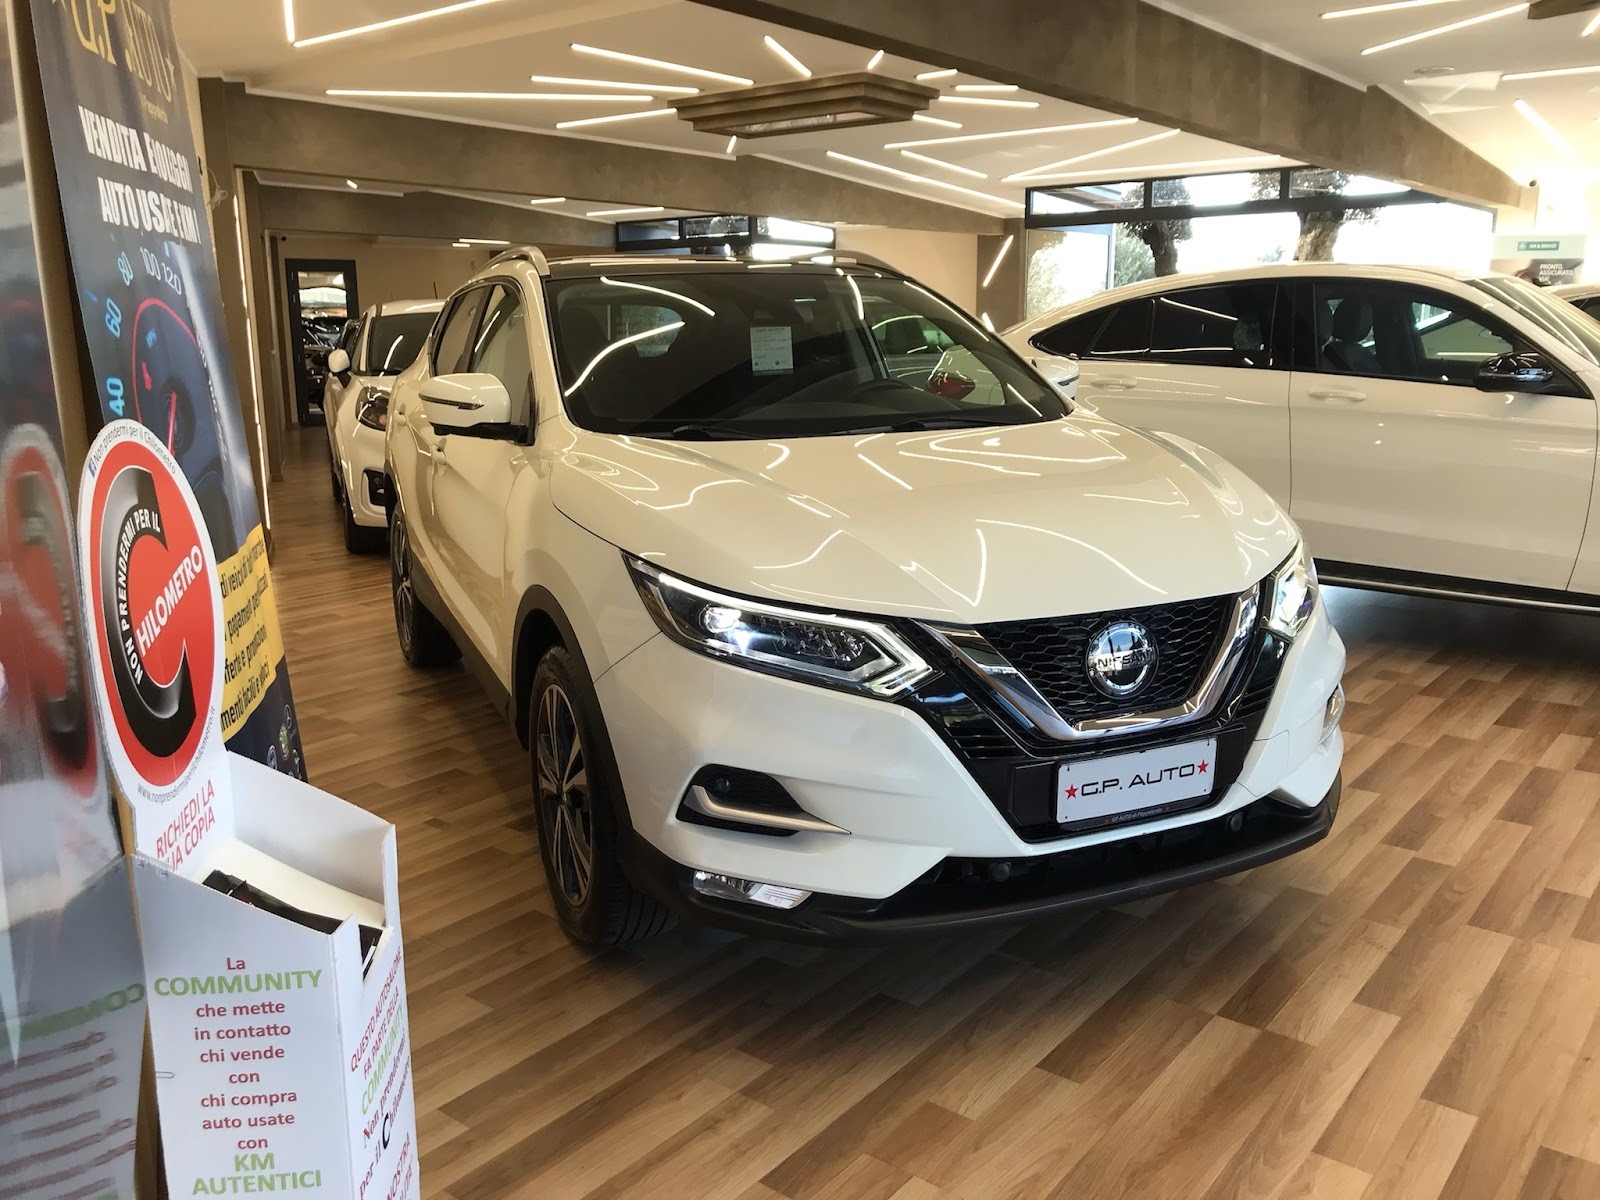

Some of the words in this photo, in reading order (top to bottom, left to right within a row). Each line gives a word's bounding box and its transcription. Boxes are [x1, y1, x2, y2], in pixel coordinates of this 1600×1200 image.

[78, 105, 147, 172] VENDITA
[97, 176, 139, 230] AUTO
[118, 251, 134, 286] 80
[140, 246, 162, 281] 100
[162, 262, 182, 296] 120
[105, 298, 122, 338] 60
[106, 376, 125, 417] 40
[133, 508, 150, 531] PER
[151, 510, 161, 533] IL
[118, 520, 136, 632] PRENDERMI
[125, 636, 143, 685] NON
[1097, 648, 1153, 667] NISSAN
[1081, 778, 1122, 797] G.P.
[1128, 763, 1195, 789] AUTO
[156, 792, 200, 859] RICHIEDI
[202, 779, 215, 808] LA
[184, 805, 216, 855] COPIA
[227, 957, 246, 970] La
[154, 969, 323, 997] COMMUNITY
[196, 1002, 227, 1018] che
[233, 1000, 286, 1016] mette
[195, 1025, 211, 1041] in
[216, 1022, 291, 1039] contatto
[350, 1016, 376, 1072] QUESTO
[364, 1057, 372, 1080] FA
[372, 1018, 387, 1062] PARTE
[386, 985, 399, 1025] DELLA
[200, 1047, 225, 1063] chi
[231, 1045, 285, 1061] vende
[229, 1070, 260, 1084] con
[200, 1092, 226, 1108] chi
[231, 1091, 297, 1106] compra
[202, 1115, 242, 1130] auto
[247, 1112, 295, 1127] usate
[363, 1109, 379, 1149] Non
[238, 1136, 268, 1150] con
[234, 1153, 276, 1172] KM
[360, 1161, 374, 1200] per
[375, 1138, 381, 1166] il
[192, 1169, 322, 1195] AUTENTICI
